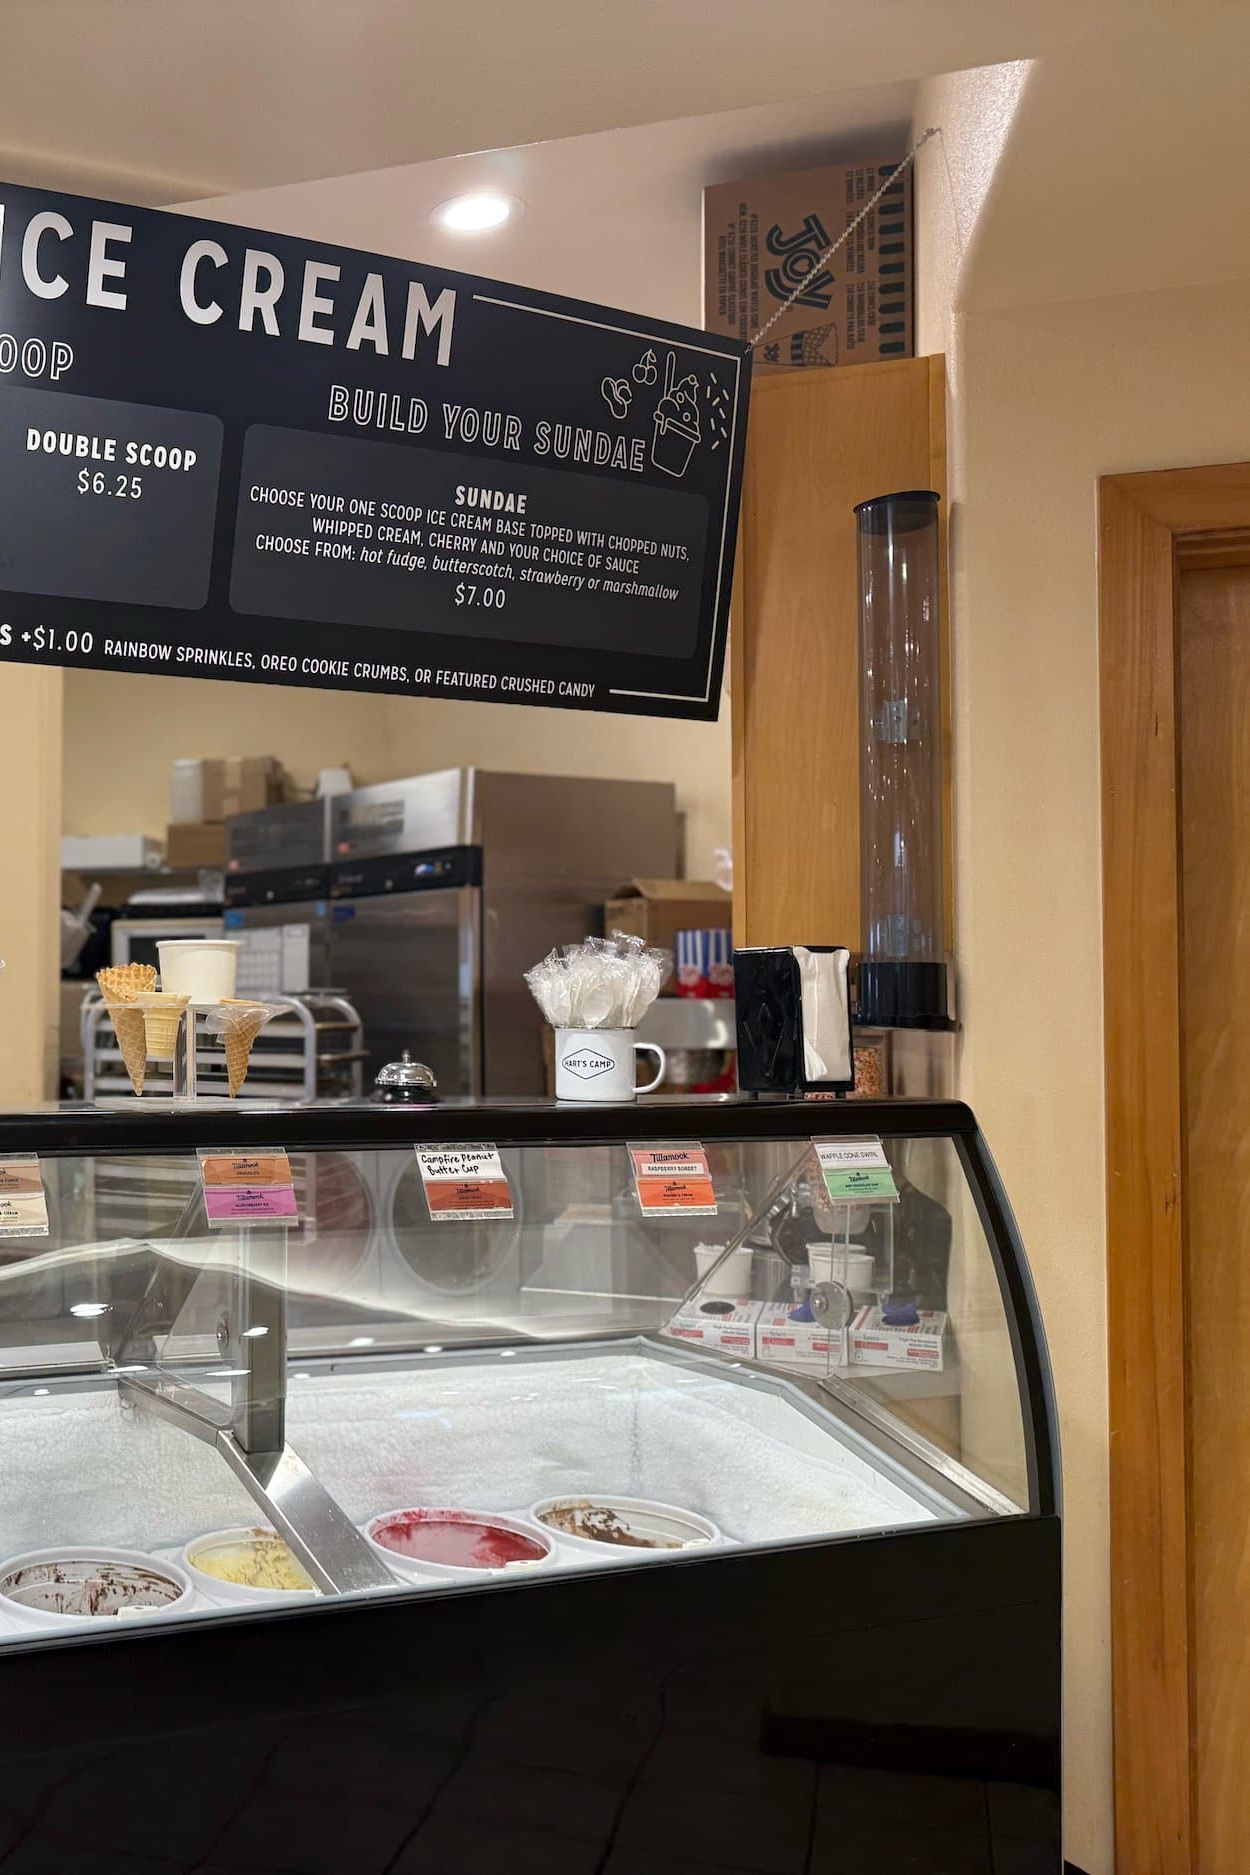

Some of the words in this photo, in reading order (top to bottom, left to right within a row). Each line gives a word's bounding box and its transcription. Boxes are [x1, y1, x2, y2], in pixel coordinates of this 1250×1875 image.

[179, 239, 457, 367] CREAM
[328, 384, 428, 434] BUILD
[442, 403, 522, 451] YOUR
[533, 421, 646, 472] SUNDAE
[26, 428, 117, 462] DOUBLE
[125, 441, 197, 472] SCOOP
[76, 467, 142, 499] $6.25
[454, 485, 527, 515] SUNDAE
[250, 485, 306, 508] CHOOSE
[309, 493, 345, 513] YOUR
[349, 498, 377, 517] ONE
[380, 502, 423, 522] SCOOP
[426, 509, 447, 526] ICE
[450, 512, 492, 532] CREAM
[495, 518, 527, 537] BASE
[530, 523, 574, 543] TOPPED
[577, 530, 605, 548] WITH
[608, 535, 658, 556] CHOPPED
[660, 543, 687, 560] NUTS,
[312, 517, 373, 539] WHIPPED
[377, 525, 424, 548] CREAM,
[428, 532, 478, 553] CHERRY
[480, 539, 505, 556] AND
[509, 542, 540, 561] YOUR
[543, 547, 584, 567] CHOICE
[587, 553, 603, 569] OF
[605, 556, 640, 574] SAUCE
[255, 534, 311, 556] CHOOSE
[314, 541, 356, 561] FROM:
[359, 546, 384, 564] hot
[386, 549, 427, 572] fudge,
[432, 554, 515, 581] butterscotch,
[519, 567, 586, 591] strawberry
[587, 578, 601, 590] or
[602, 580, 679, 600] marshmallow
[454, 581, 506, 609] $7.00
[21, 624, 94, 654] +$1.00
[104, 639, 173, 661] RAINBOW
[175, 646, 256, 670] SPRINKLES,
[260, 654, 298, 672] OREO
[301, 657, 350, 677] COOKIE
[353, 662, 410, 683] CRUMBS,
[414, 668, 432, 684] OR
[435, 669, 497, 689] FEATURED
[500, 675, 555, 694] CRUSHED
[558, 681, 596, 698] CANDY
[565, 1060, 587, 1068] HART'S
[421, 1154, 460, 1164] Campfire
[462, 1153, 494, 1162] Peanut
[427, 1165, 460, 1176] Butter
[461, 1164, 479, 1174] Cup
[650, 1152, 688, 1163] Tillamook
[820, 1152, 843, 1160] WAFFLE
